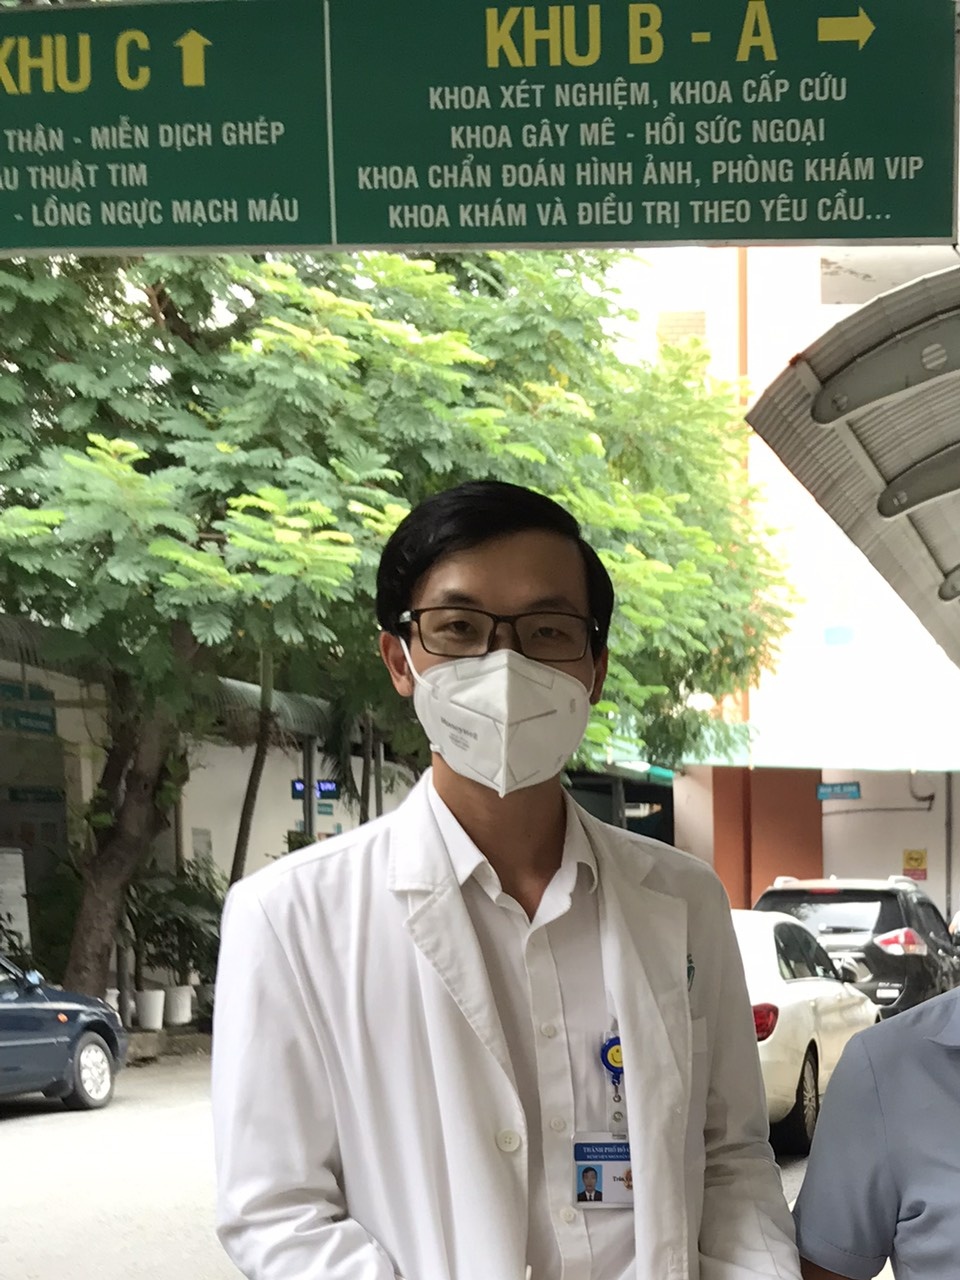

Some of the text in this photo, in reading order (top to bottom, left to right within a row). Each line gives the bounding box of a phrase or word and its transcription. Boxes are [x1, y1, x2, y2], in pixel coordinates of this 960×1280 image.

[486, 4, 600, 68] KHU
[629, 4, 664, 64] B
[736, 1, 777, 61] A
[116, 30, 150, 90] C
[430, 70, 846, 110] KHOA XÉT NGHIỆM, KHOA CẤP CỨU
[4, 124, 64, 156] THẬN
[91, 116, 148, 149] MIỄN
[159, 124, 212, 151] DỊCH
[222, 116, 284, 145] GHÉP
[451, 125, 512, 148] KHOA
[522, 119, 569, 147] GÂY
[580, 117, 615, 146] MÊ
[646, 112, 684, 144] HỒI
[696, 115, 741, 144] SỨC
[753, 118, 824, 146] NGOẠI
[27, 160, 98, 192] THUẬT
[107, 164, 147, 186] TIM
[358, 152, 923, 189] KHOA CHẨN ĐOÁN HÌNH ẢNH, PHÒNG KHÁM VIP
[32, 195, 91, 226] LỒNG
[101, 198, 162, 228] NGỰC
[172, 199, 238, 226] MẠCH
[248, 194, 298, 221] MÁU
[389, 189, 890, 228] KHOA KHÁM VÀ ĐIỀU TRỊ THEO YÊU CẦU...
